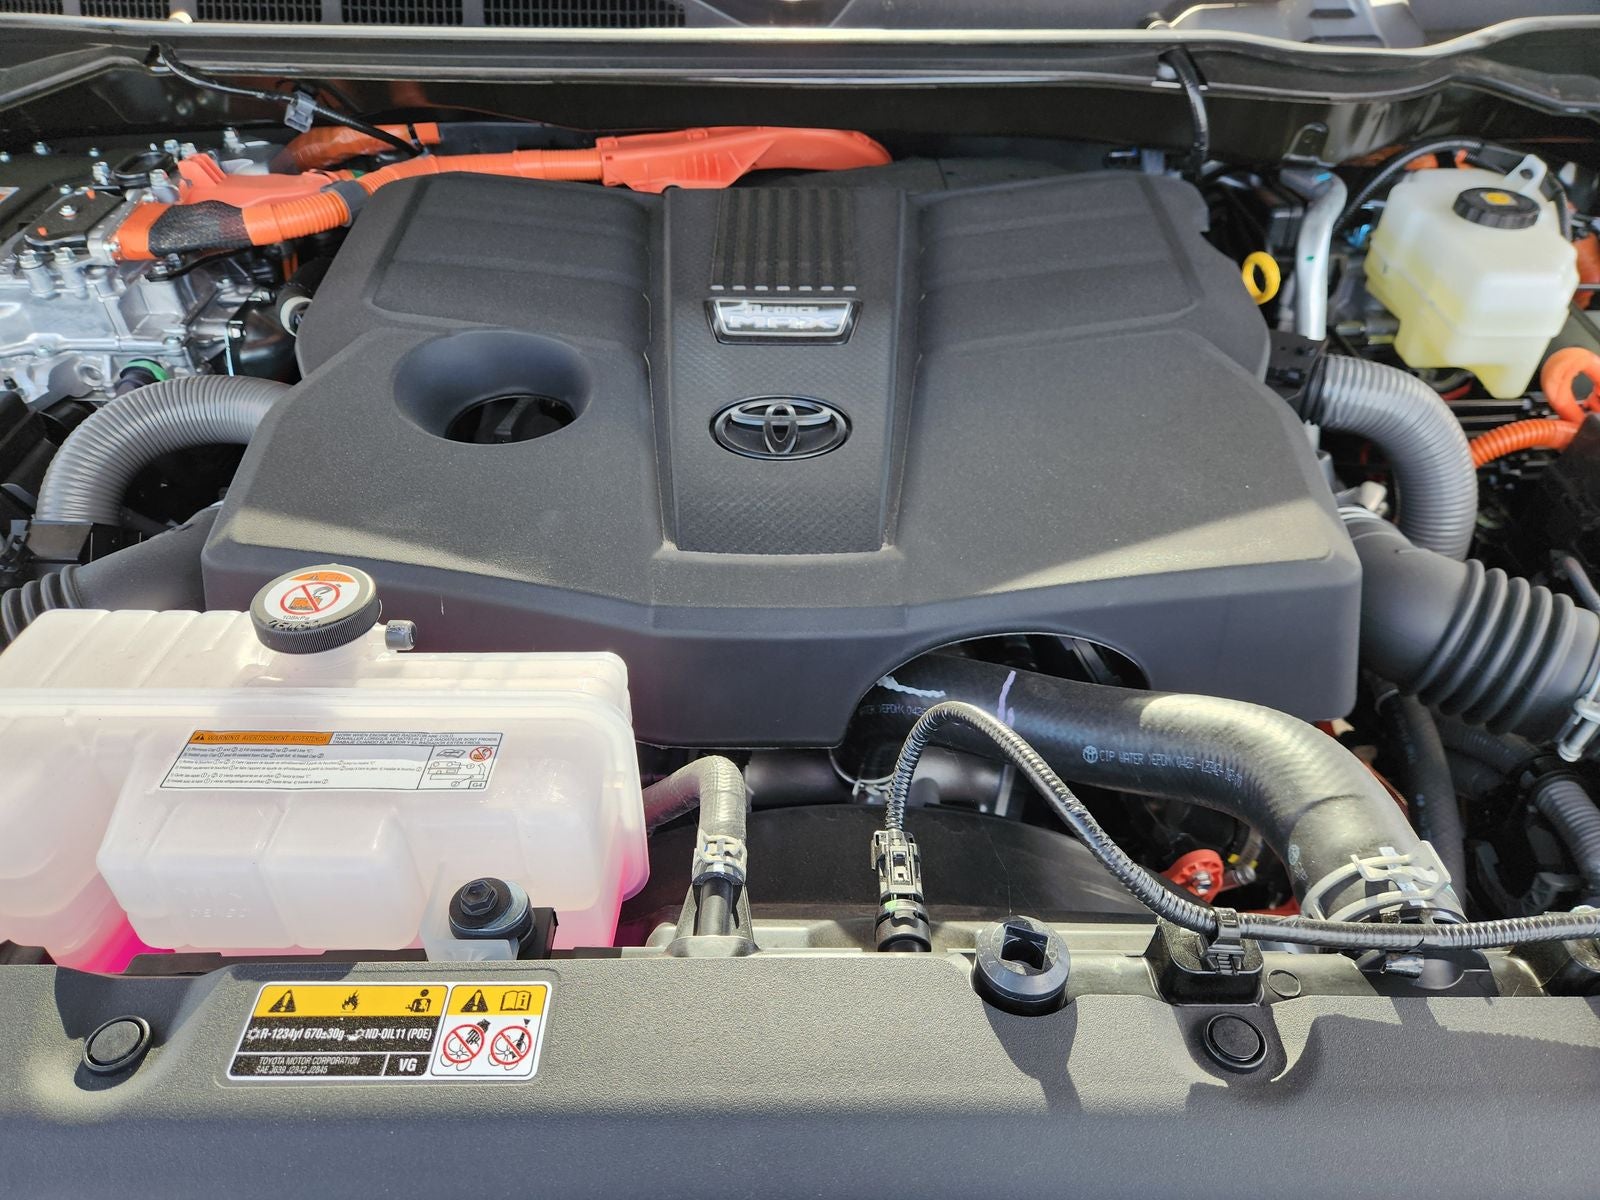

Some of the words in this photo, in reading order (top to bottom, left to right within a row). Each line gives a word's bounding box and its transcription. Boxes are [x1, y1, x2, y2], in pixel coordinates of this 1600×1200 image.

[729, 316, 839, 329] MAX
[304, 1027, 345, 1041] 670±30g
[407, 1027, 433, 1041] (POE)
[259, 1056, 286, 1066] TOYOTA
[286, 1056, 311, 1066] MOTOR
[311, 1056, 361, 1066] CORPORATION
[399, 1057, 419, 1072] VG
[255, 1065, 270, 1075] SAE
